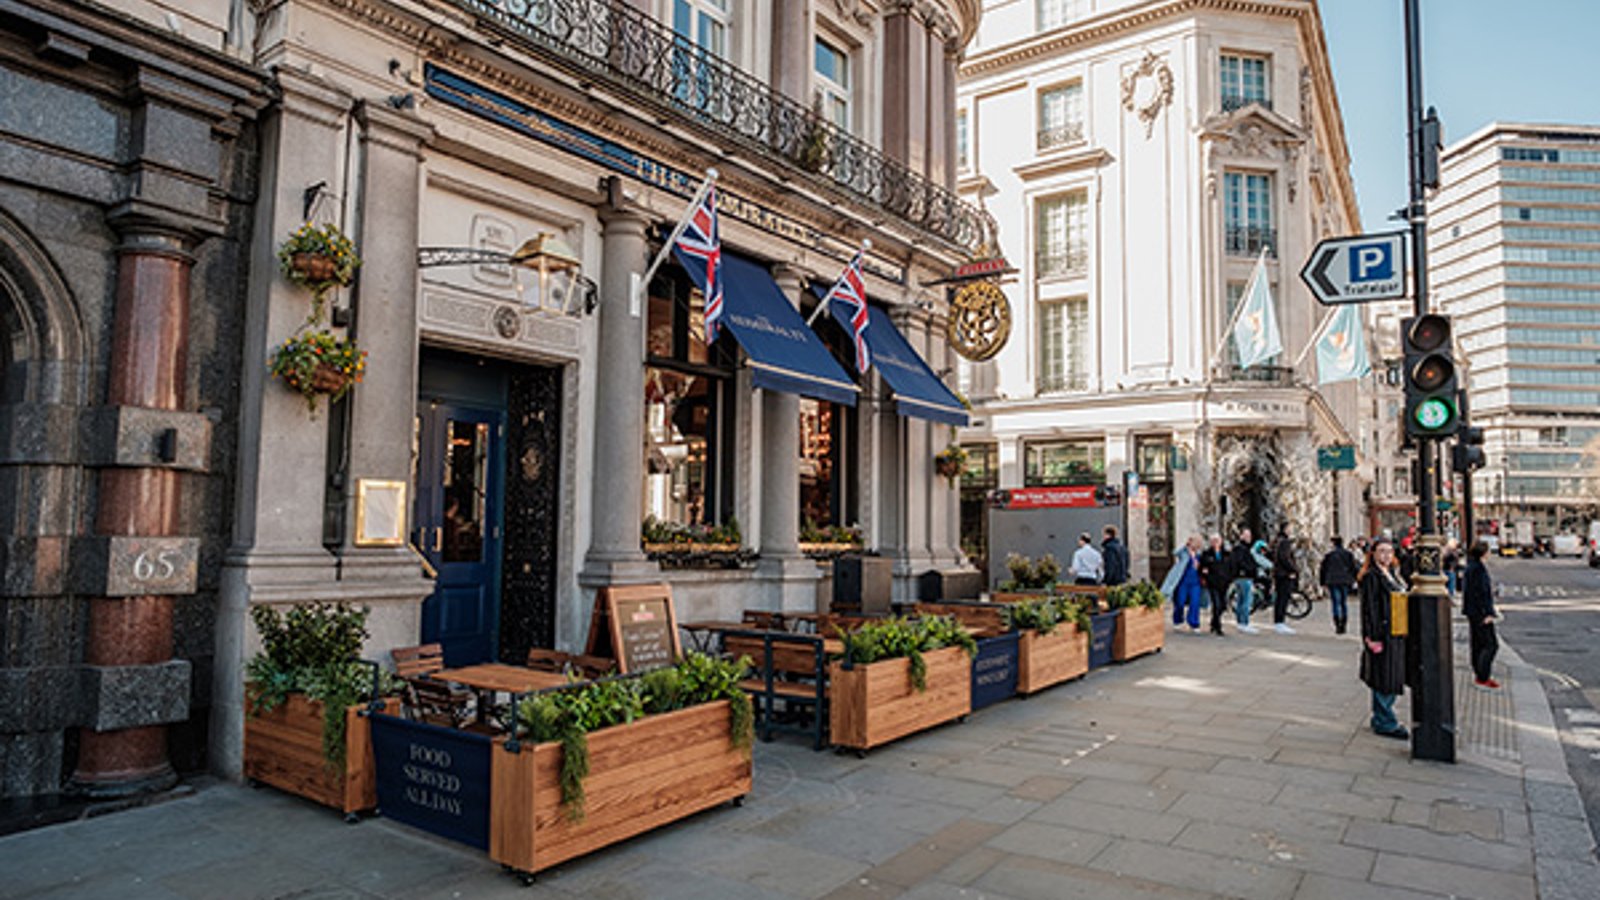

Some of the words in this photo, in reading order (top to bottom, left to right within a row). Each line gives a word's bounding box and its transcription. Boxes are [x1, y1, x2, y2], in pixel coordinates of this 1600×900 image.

[714, 190, 821, 247] DMIRALTY
[1358, 246, 1385, 278] P
[133, 550, 175, 580] 65
[409, 743, 452, 769] FOOD
[403, 763, 461, 793] SERVED
